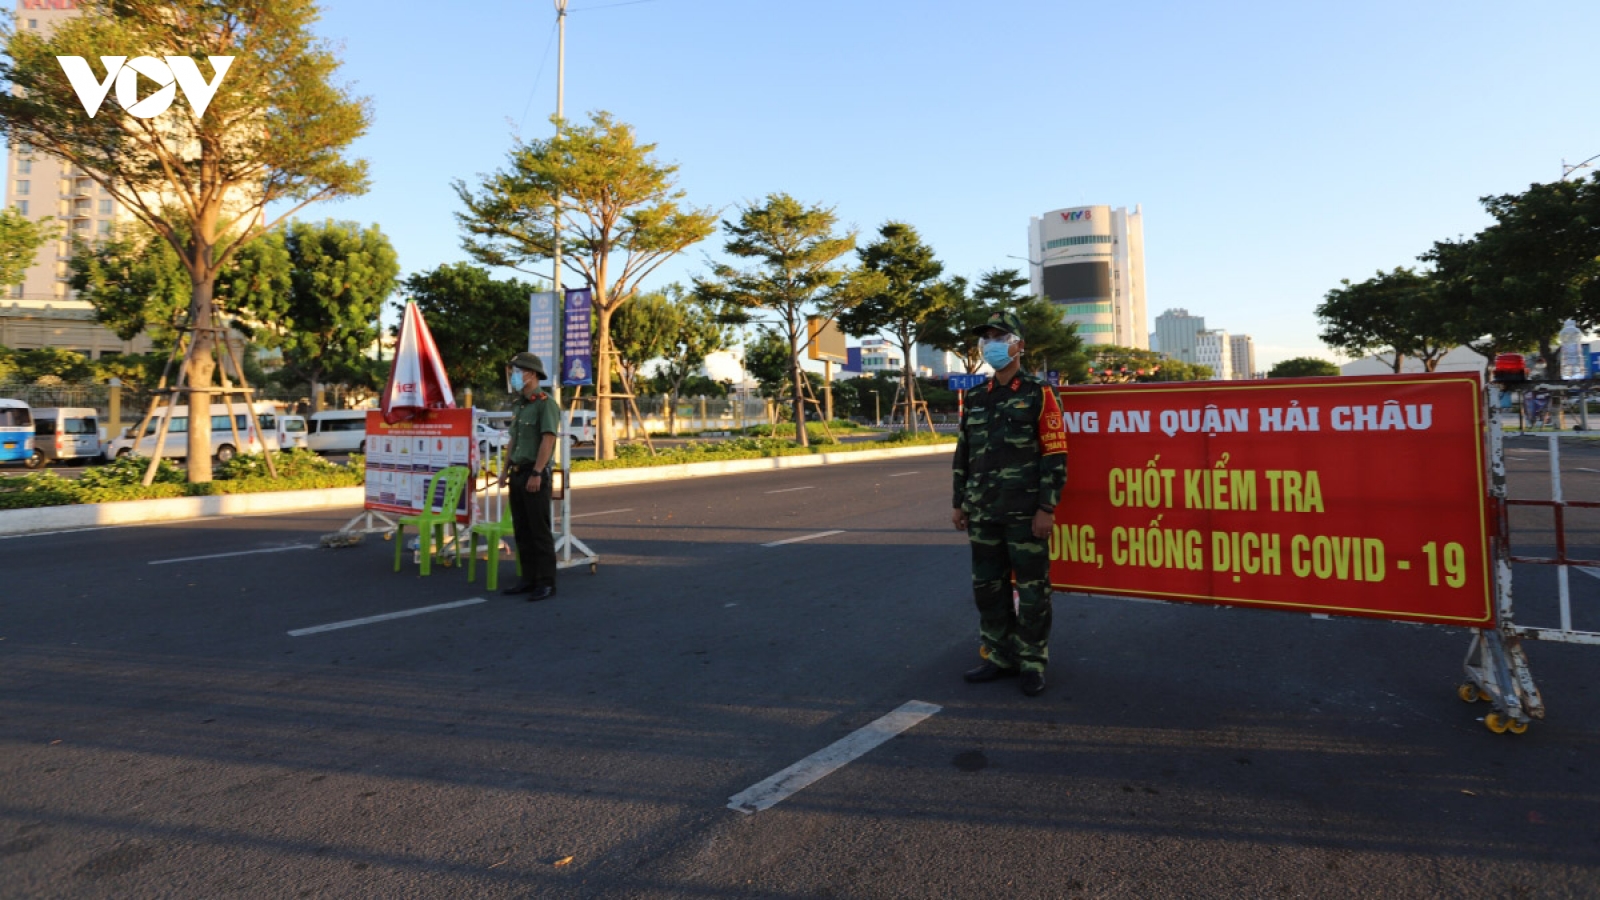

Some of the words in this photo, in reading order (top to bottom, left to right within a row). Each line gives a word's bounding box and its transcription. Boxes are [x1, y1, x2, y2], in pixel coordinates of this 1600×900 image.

[1062, 411, 1099, 433] NG
[1107, 410, 1151, 433] AN
[1159, 404, 1249, 438] QUẬN
[1258, 399, 1320, 432] HẢI
[1330, 399, 1433, 431] CHÂU
[1108, 453, 1176, 509] CHỐT
[1183, 451, 1257, 511] KIỂM
[1264, 469, 1325, 513] TRA
[1111, 513, 1204, 571] CHỐNG
[1211, 530, 1282, 583] DỊCH
[1291, 534, 1386, 583] COVID
[1397, 560, 1411, 570] -
[1421, 541, 1467, 589] 19
